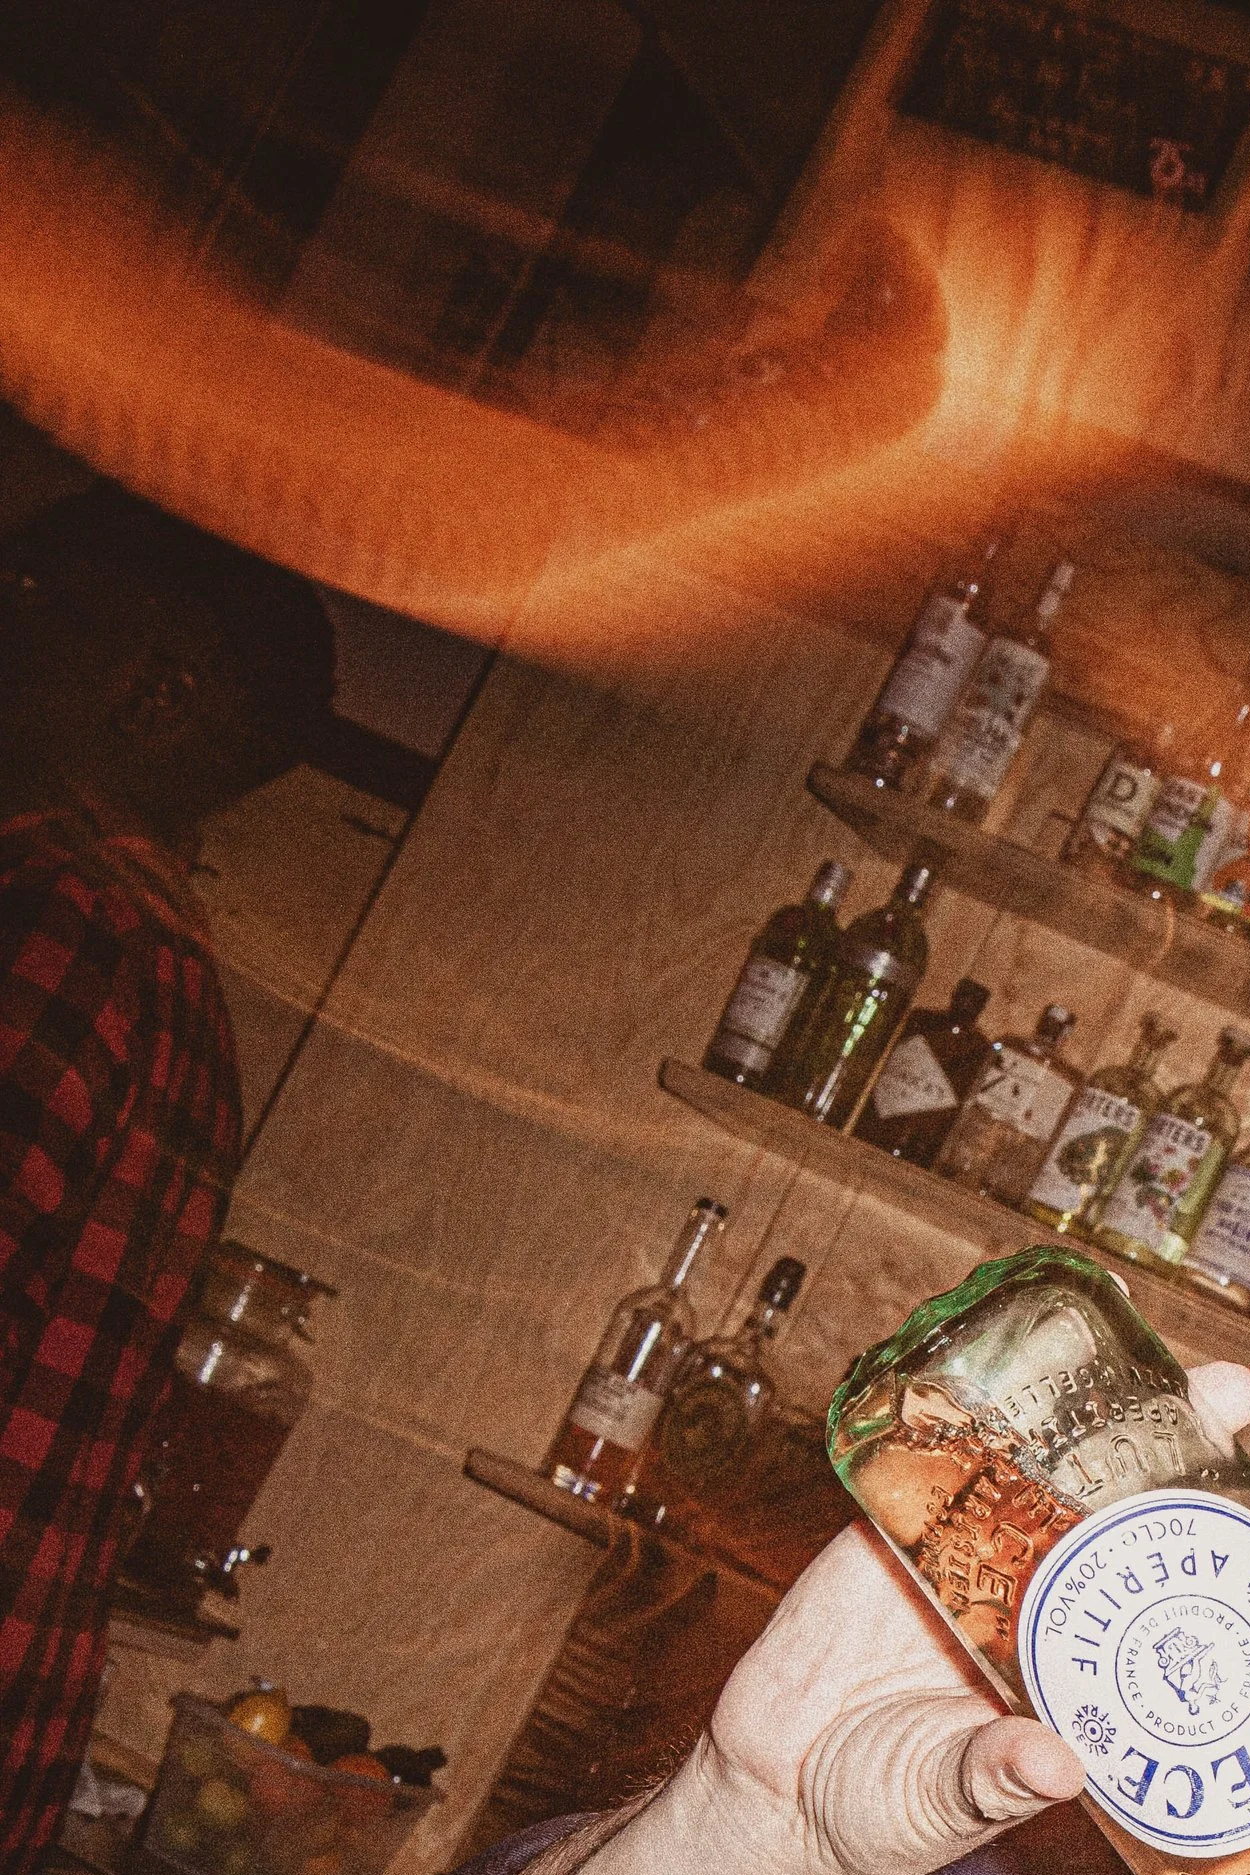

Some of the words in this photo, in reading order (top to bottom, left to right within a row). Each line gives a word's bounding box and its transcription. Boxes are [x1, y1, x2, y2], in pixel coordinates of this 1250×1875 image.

[1071, 1548, 1230, 1678] APÉRITIF
[1145, 1710, 1215, 1736] PRODUCT
[1220, 1701, 1239, 1722] OF
